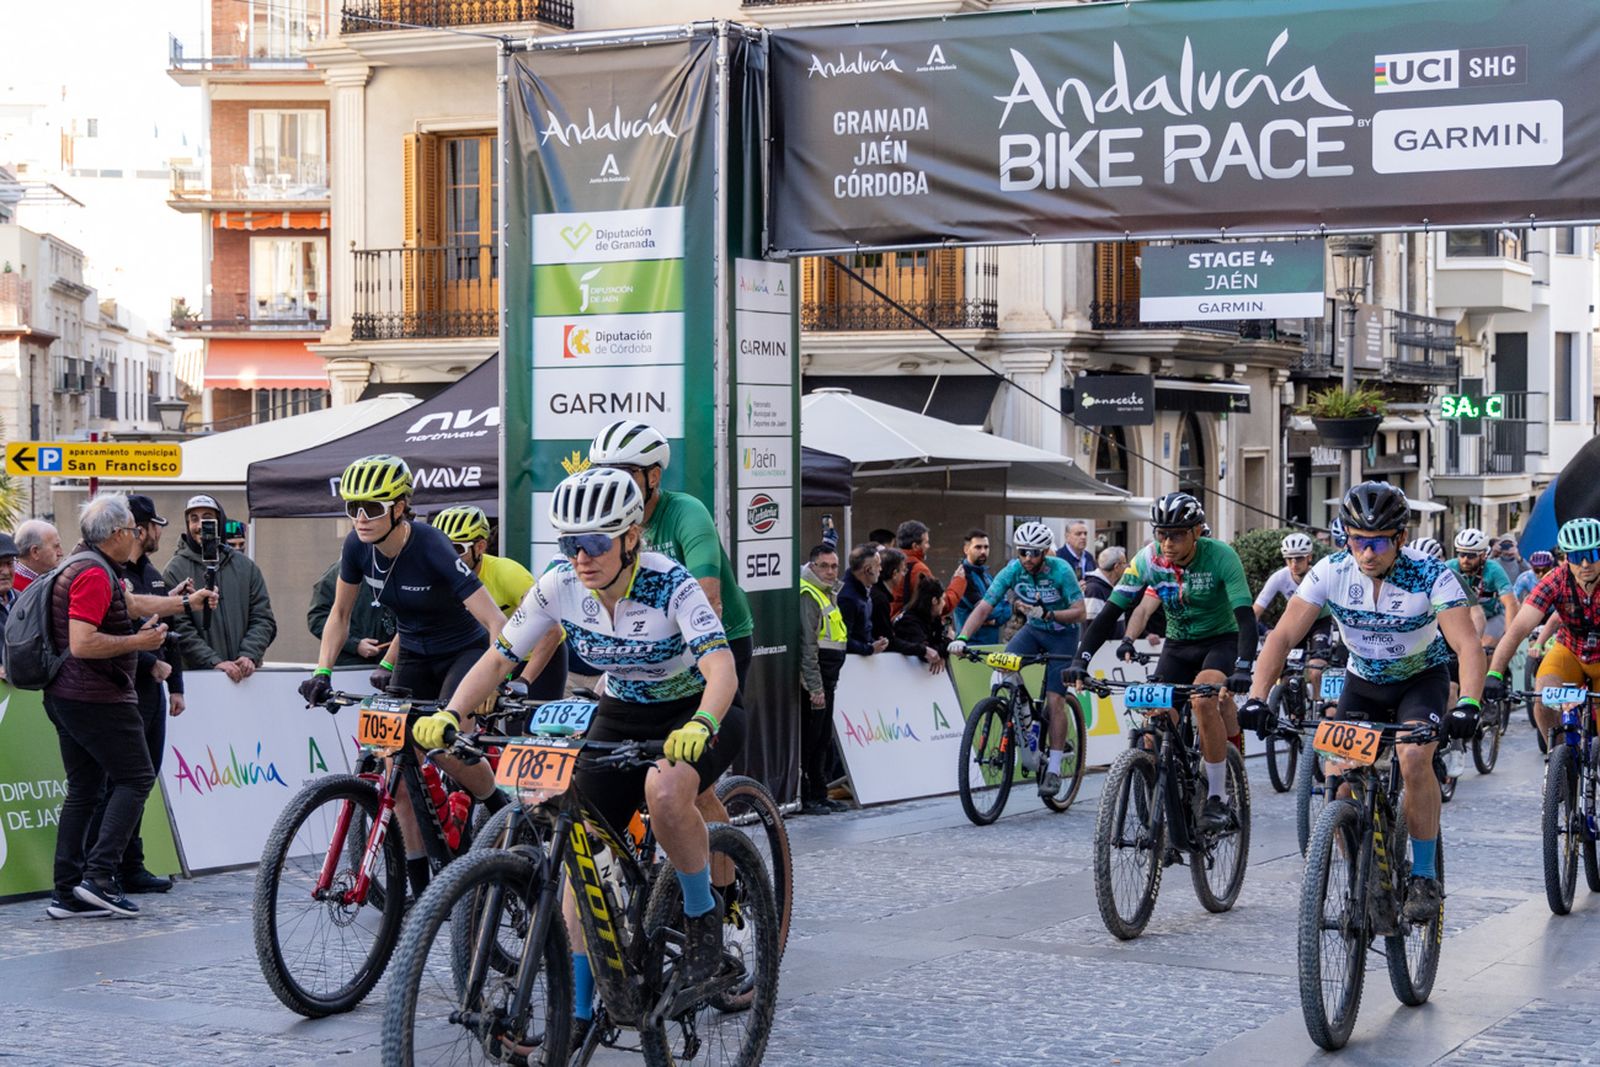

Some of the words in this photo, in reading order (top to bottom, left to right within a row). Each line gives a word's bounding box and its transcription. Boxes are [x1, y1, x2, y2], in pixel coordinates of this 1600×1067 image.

[808, 49, 904, 78] Andalucía
[1388, 57, 1453, 85] UCI
[1469, 56, 1516, 78] SHC
[994, 28, 1353, 129] Andalucía
[540, 102, 677, 147] Andalucía
[833, 106, 929, 135] GRANADA
[1357, 118, 1371, 127] BY
[1394, 122, 1542, 151] GARMIN
[854, 135, 907, 166] JAÉN
[1000, 127, 1143, 192] BIKE
[1164, 115, 1353, 185] RACE
[834, 168, 929, 198] CÓRDOBA
[595, 241, 608, 251] de
[611, 238, 655, 250] Granada
[596, 228, 652, 241] Diputación
[1188, 251, 1255, 269] STAGE
[1259, 250, 1274, 266] 4
[1204, 271, 1258, 290] JAÉN
[1198, 301, 1264, 313] GARMIN
[595, 330, 652, 343] Diputación
[595, 344, 608, 354] de
[610, 342, 652, 354] Córdoba
[740, 339, 786, 357] GARMIN
[549, 391, 665, 414] GARMIN
[69, 449, 129, 457] aparcamiento
[134, 449, 177, 457] municipal
[752, 447, 777, 469] Jaén
[68, 460, 96, 470] San
[106, 459, 177, 472] Francisco
[591, 643, 656, 654] SCOTT
[990, 653, 1017, 669] 340-1
[1128, 685, 1168, 703] 518-1
[537, 704, 590, 724] 518-2
[363, 714, 402, 740] 705-2
[841, 707, 920, 748] Andalucía
[1321, 722, 1376, 756] 708-2
[171, 741, 289, 795] Andalucía
[506, 748, 569, 782] 708-1
[7, 810, 34, 830] DE
[36, 803, 62, 828] JAÉ
[570, 822, 626, 976] SCOTT
